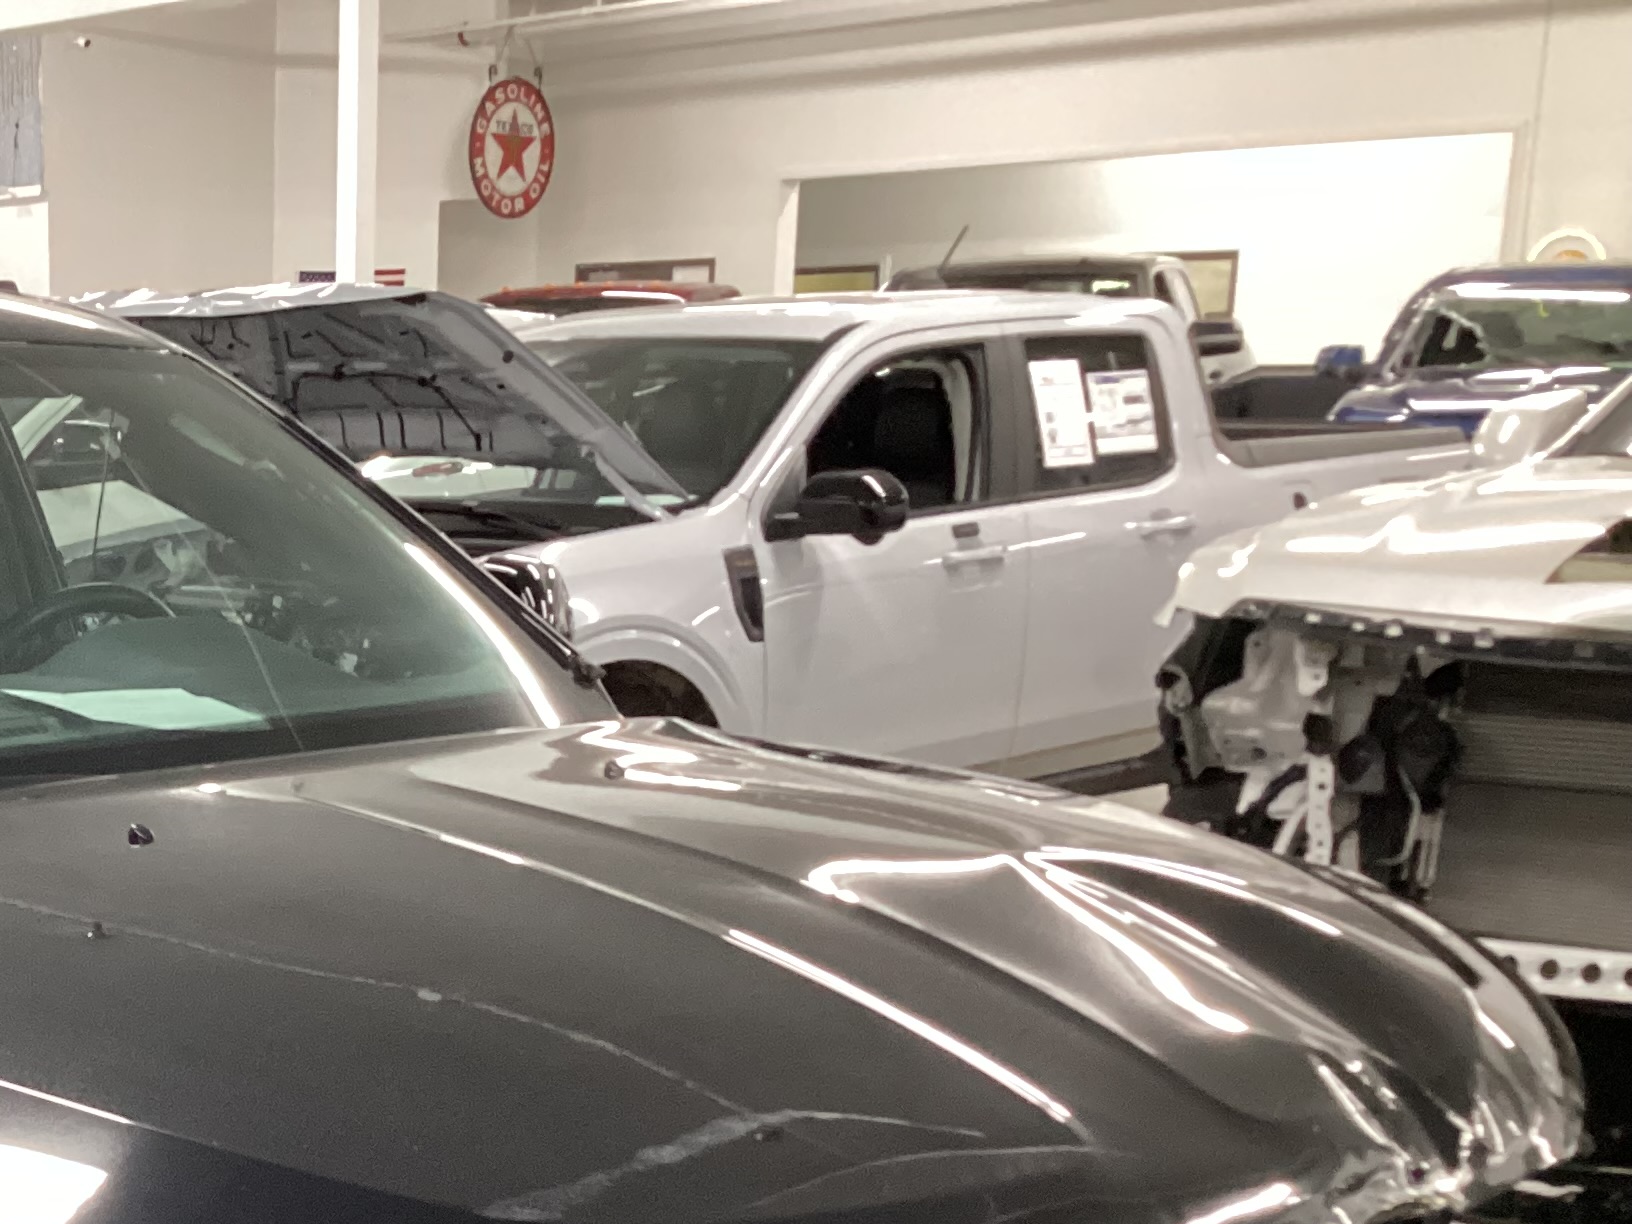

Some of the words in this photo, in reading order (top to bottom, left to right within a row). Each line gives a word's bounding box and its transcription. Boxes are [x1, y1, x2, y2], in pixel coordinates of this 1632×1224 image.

[476, 83, 551, 139] GASOLINE
[473, 157, 525, 214] MOTOR
[529, 160, 551, 200] OIL
